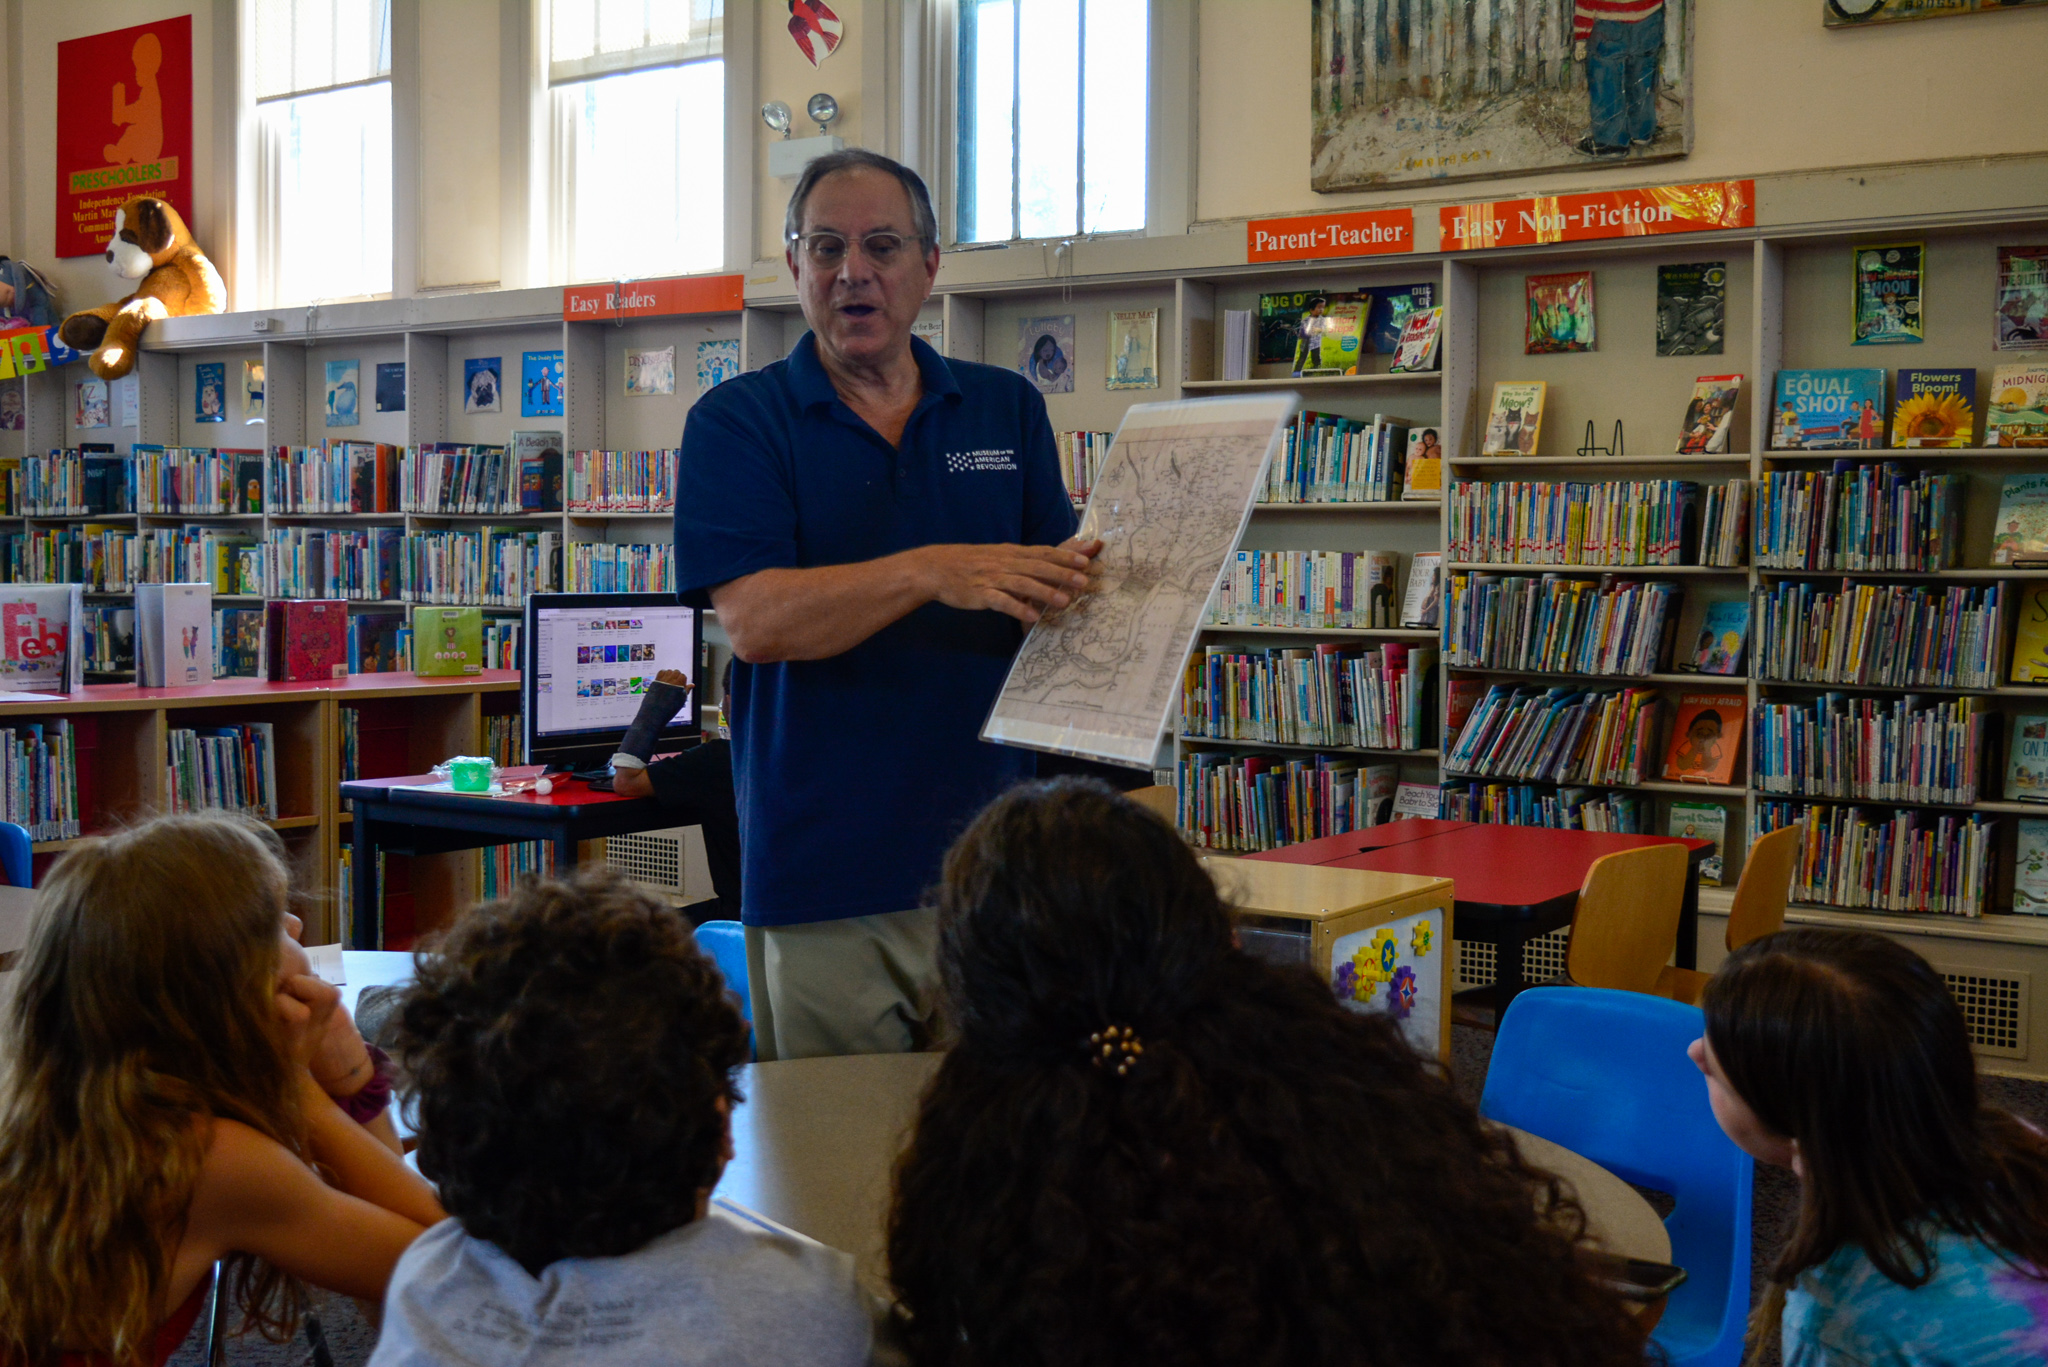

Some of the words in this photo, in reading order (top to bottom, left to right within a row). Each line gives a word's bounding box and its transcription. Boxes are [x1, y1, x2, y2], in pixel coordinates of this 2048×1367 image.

[73, 163, 162, 191] PRESCHOOLERS
[79, 196, 125, 211] Independence
[73, 211, 98, 222] Martin
[1452, 215, 1507, 240] Easy
[1517, 200, 1673, 234] Non-Fiction
[1254, 222, 1403, 252] Parent-Teacher
[1871, 280, 1910, 296] MOON
[570, 295, 600, 315] Easy
[605, 291, 656, 311] Readers
[1261, 295, 1290, 309] BUG
[1330, 315, 1357, 324] mart
[1029, 321, 1064, 336] Lullaby
[1910, 373, 1961, 382] Flowers
[1785, 378, 1854, 396] EQUAL
[1912, 383, 1958, 393] Bloom!
[1795, 395, 1849, 413] SHOT
[972, 449, 1000, 457] MUSEUM
[2004, 480, 2037, 499] Plants
[1683, 696, 1698, 704] WAY
[1700, 697, 1716, 705] PAST
[1717, 698, 1742, 706] AFRAID
[2023, 740, 2039, 757] ON
[1399, 796, 1418, 805] Baby
[1404, 788, 1425, 798] Teach
[1426, 791, 1439, 799] You
